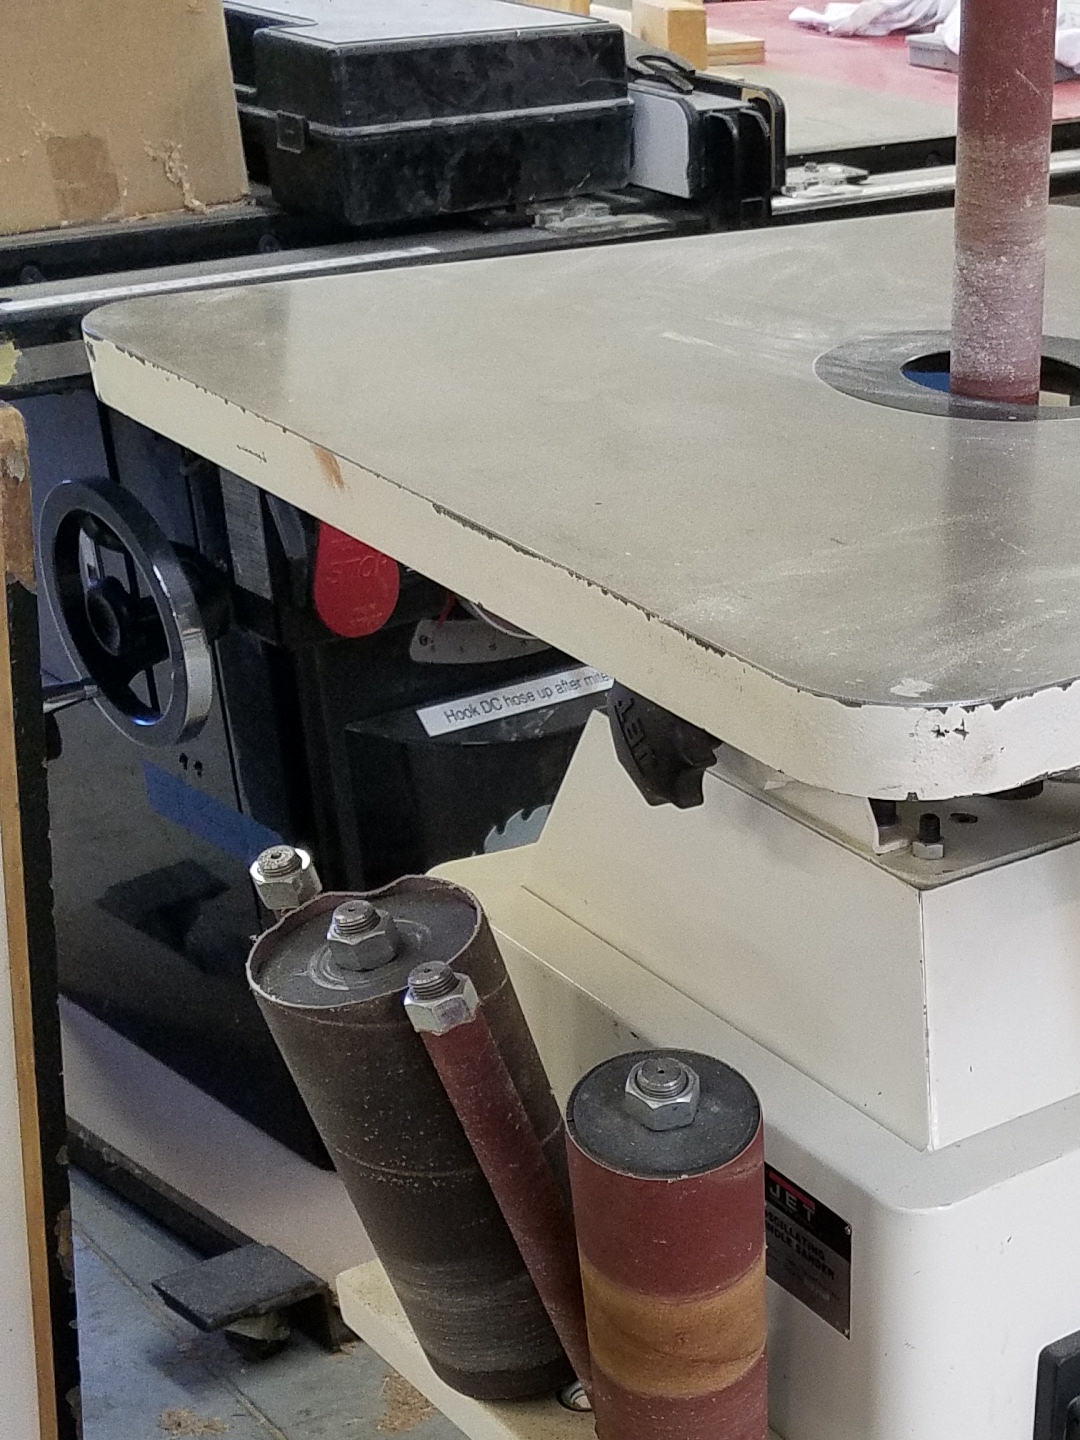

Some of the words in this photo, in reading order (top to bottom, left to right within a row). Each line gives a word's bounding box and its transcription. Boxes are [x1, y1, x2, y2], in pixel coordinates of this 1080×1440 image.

[443, 705, 478, 724] Hook
[479, 697, 503, 714] DC
[503, 688, 536, 708] hose
[537, 686, 553, 700] up
[556, 679, 582, 695] after
[769, 1184, 815, 1222] JET
